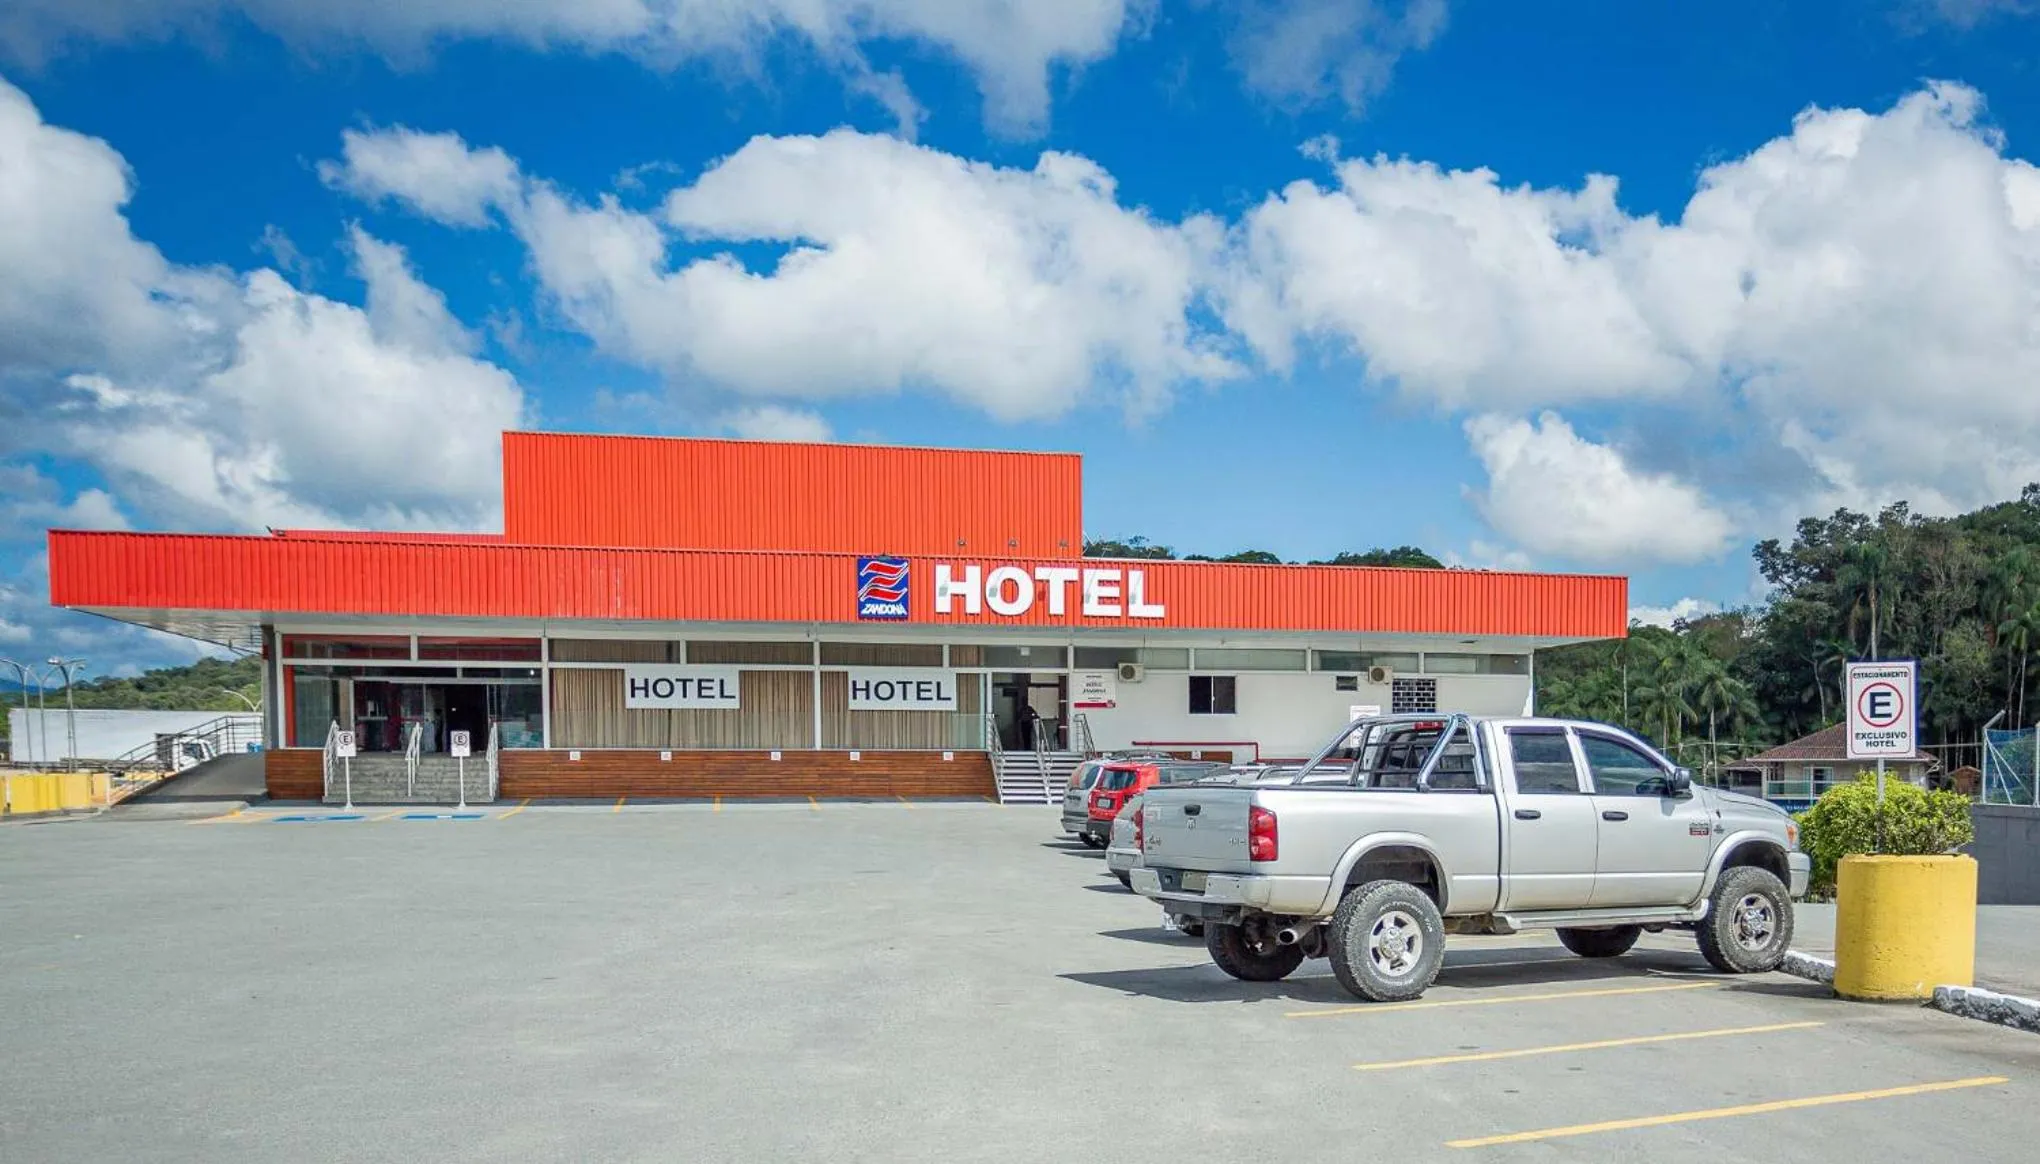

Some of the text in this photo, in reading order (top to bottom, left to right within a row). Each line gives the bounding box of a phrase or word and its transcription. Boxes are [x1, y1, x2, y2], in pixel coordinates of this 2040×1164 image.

[935, 564, 1165, 618] HOTEL
[1853, 671, 1908, 679] ESTACIONAMENTO
[629, 678, 737, 699] HOTEL
[851, 680, 952, 701] HOTEL
[1869, 692, 1893, 719] E
[1855, 731, 1908, 741] EXCLUSIVO
[1865, 740, 1897, 748] HOTEL
